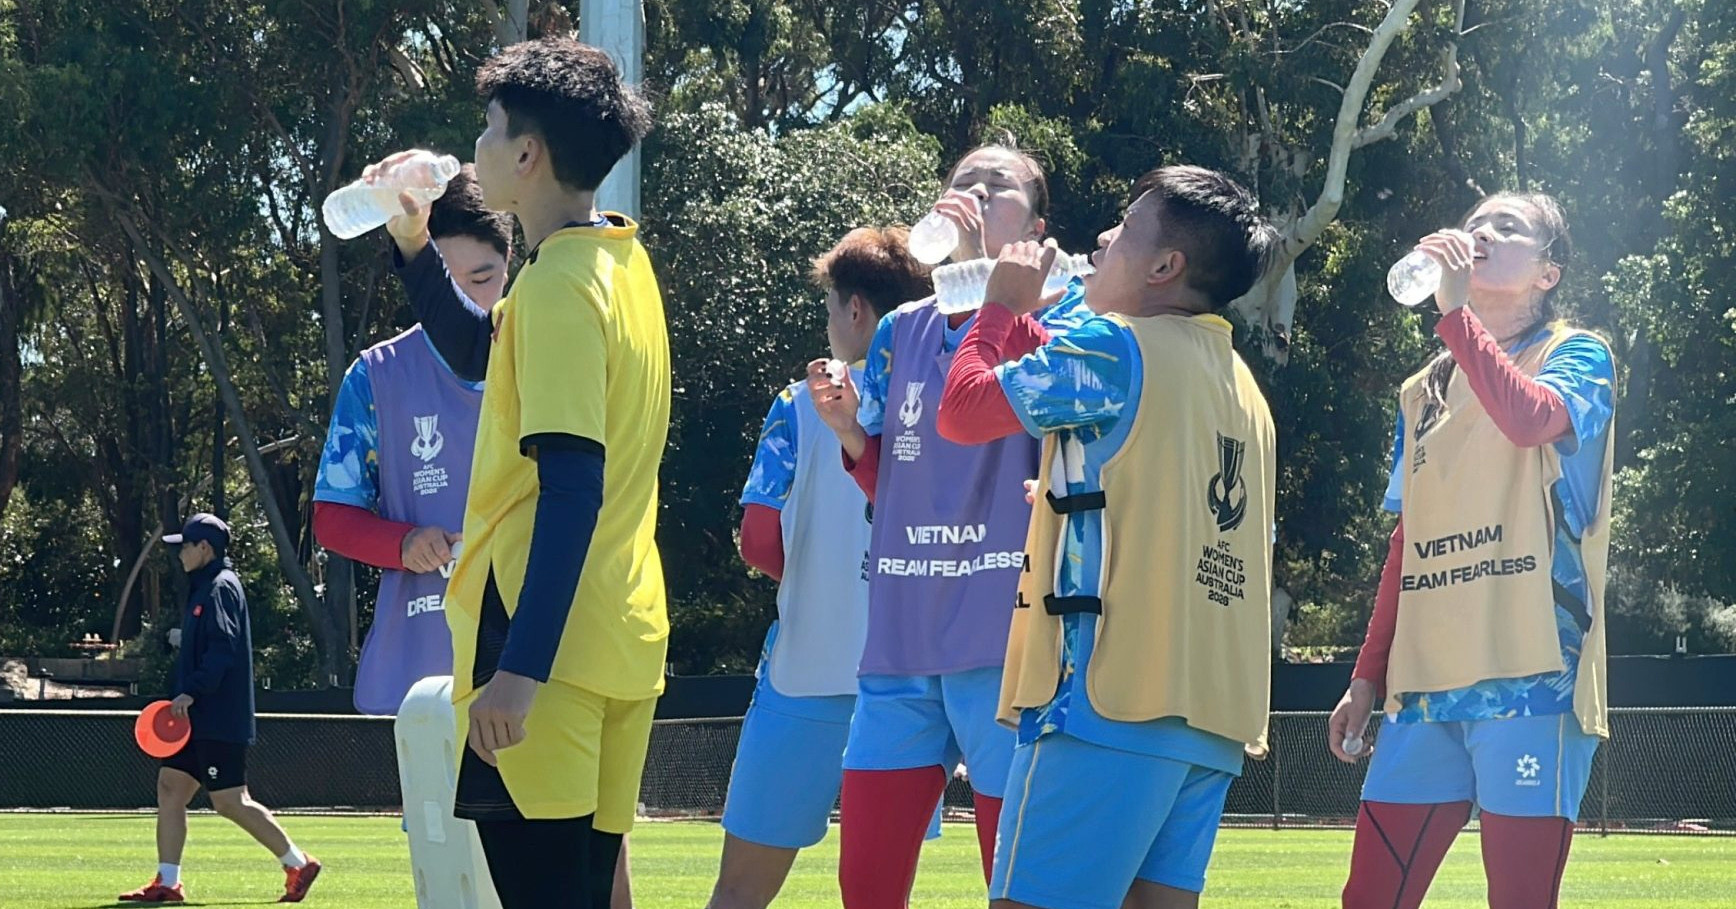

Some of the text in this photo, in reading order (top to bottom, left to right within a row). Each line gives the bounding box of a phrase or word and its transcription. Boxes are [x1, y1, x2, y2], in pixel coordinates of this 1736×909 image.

[1217, 539, 1230, 553] AFC
[1414, 524, 1503, 559] VIETNAM
[877, 557, 927, 577] REAM
[1197, 558, 1246, 586] ASIAN CUP
[1202, 545, 1244, 572] WOMEN'S
[1195, 572, 1245, 600] AUSTRALIA
[1401, 555, 1537, 591] EAM FEARLESS
[407, 594, 446, 617] DRE
